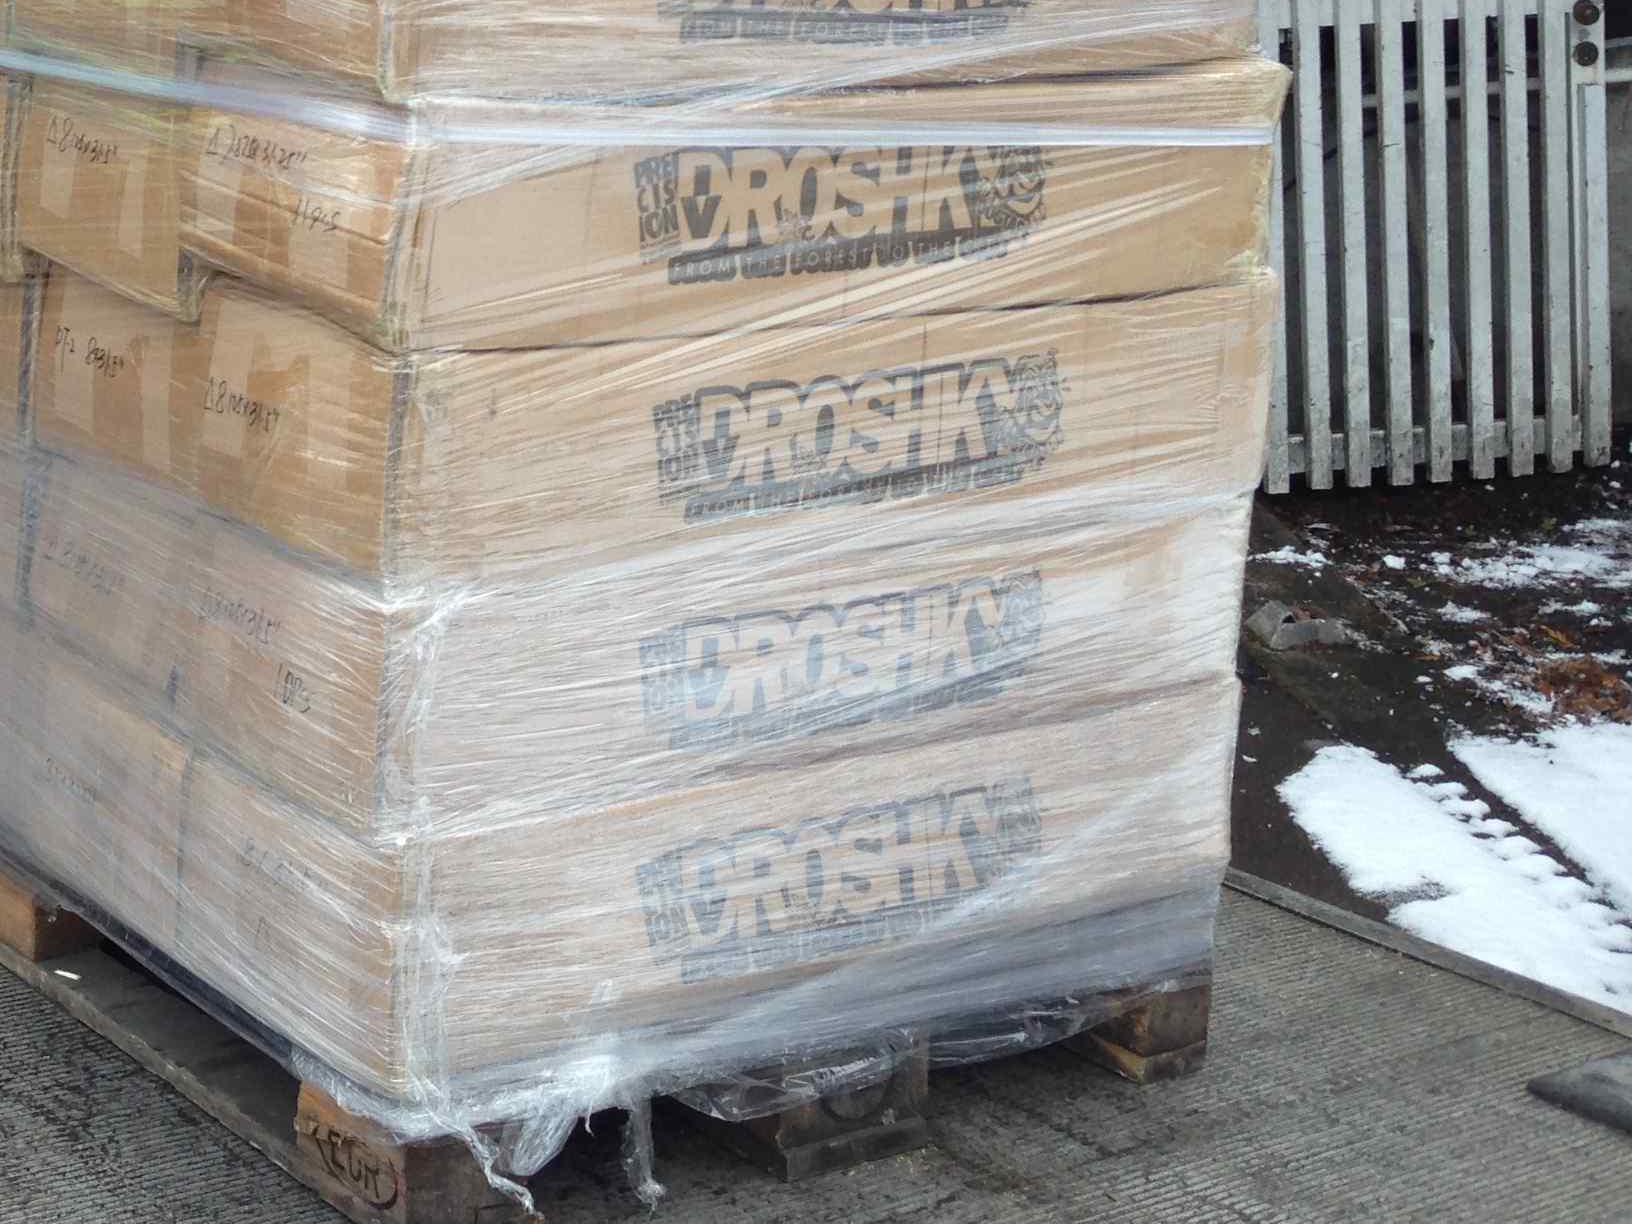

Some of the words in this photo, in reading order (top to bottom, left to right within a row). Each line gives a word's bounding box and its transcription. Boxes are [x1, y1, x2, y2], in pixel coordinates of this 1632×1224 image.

[673, 260, 732, 277] FROM
[746, 255, 784, 271] THE
[793, 246, 871, 268] FOREST
